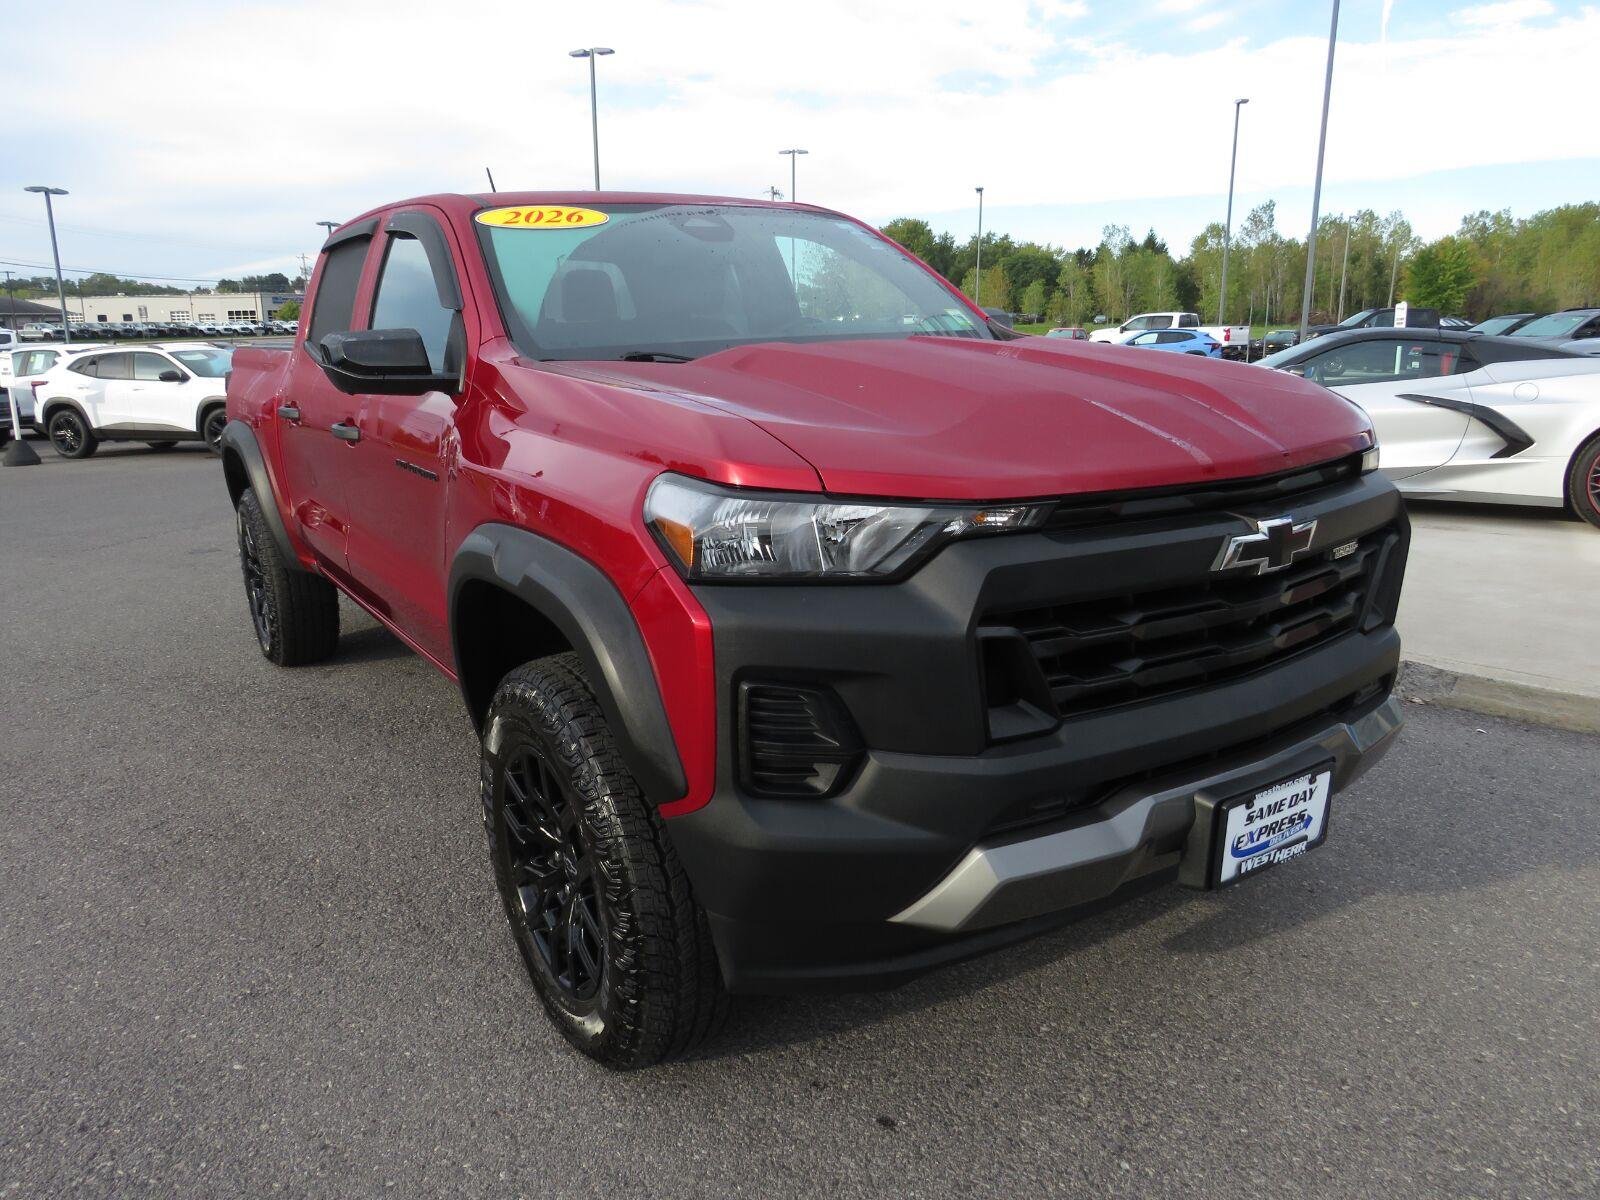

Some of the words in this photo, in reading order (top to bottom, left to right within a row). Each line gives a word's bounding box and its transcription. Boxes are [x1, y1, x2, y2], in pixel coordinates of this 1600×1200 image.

[503, 210, 584, 224] 2026
[1245, 798, 1287, 826] SAME
[1287, 785, 1317, 809] DAY
[1236, 809, 1307, 850] EXPRESS
